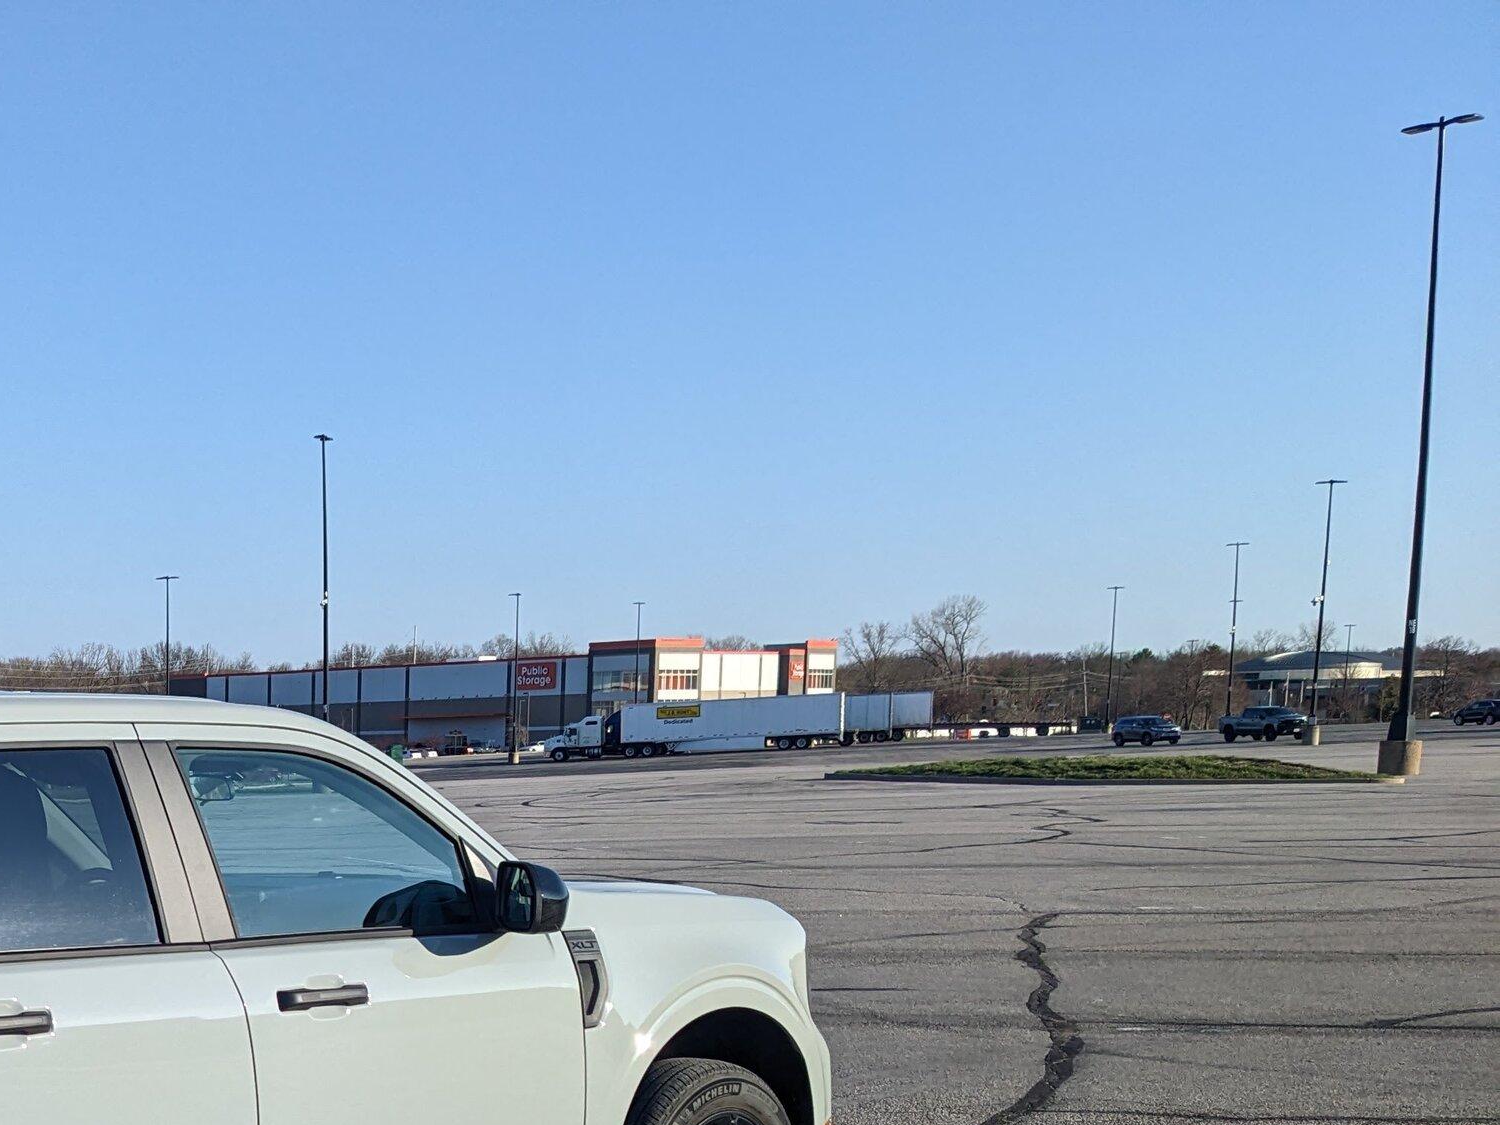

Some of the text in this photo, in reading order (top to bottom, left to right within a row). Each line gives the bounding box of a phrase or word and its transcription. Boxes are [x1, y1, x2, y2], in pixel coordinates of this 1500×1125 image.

[521, 666, 549, 676] Public
[517, 676, 552, 687] Storage
[571, 940, 597, 949] XLT
[692, 1083, 741, 1112] MICHELIN
